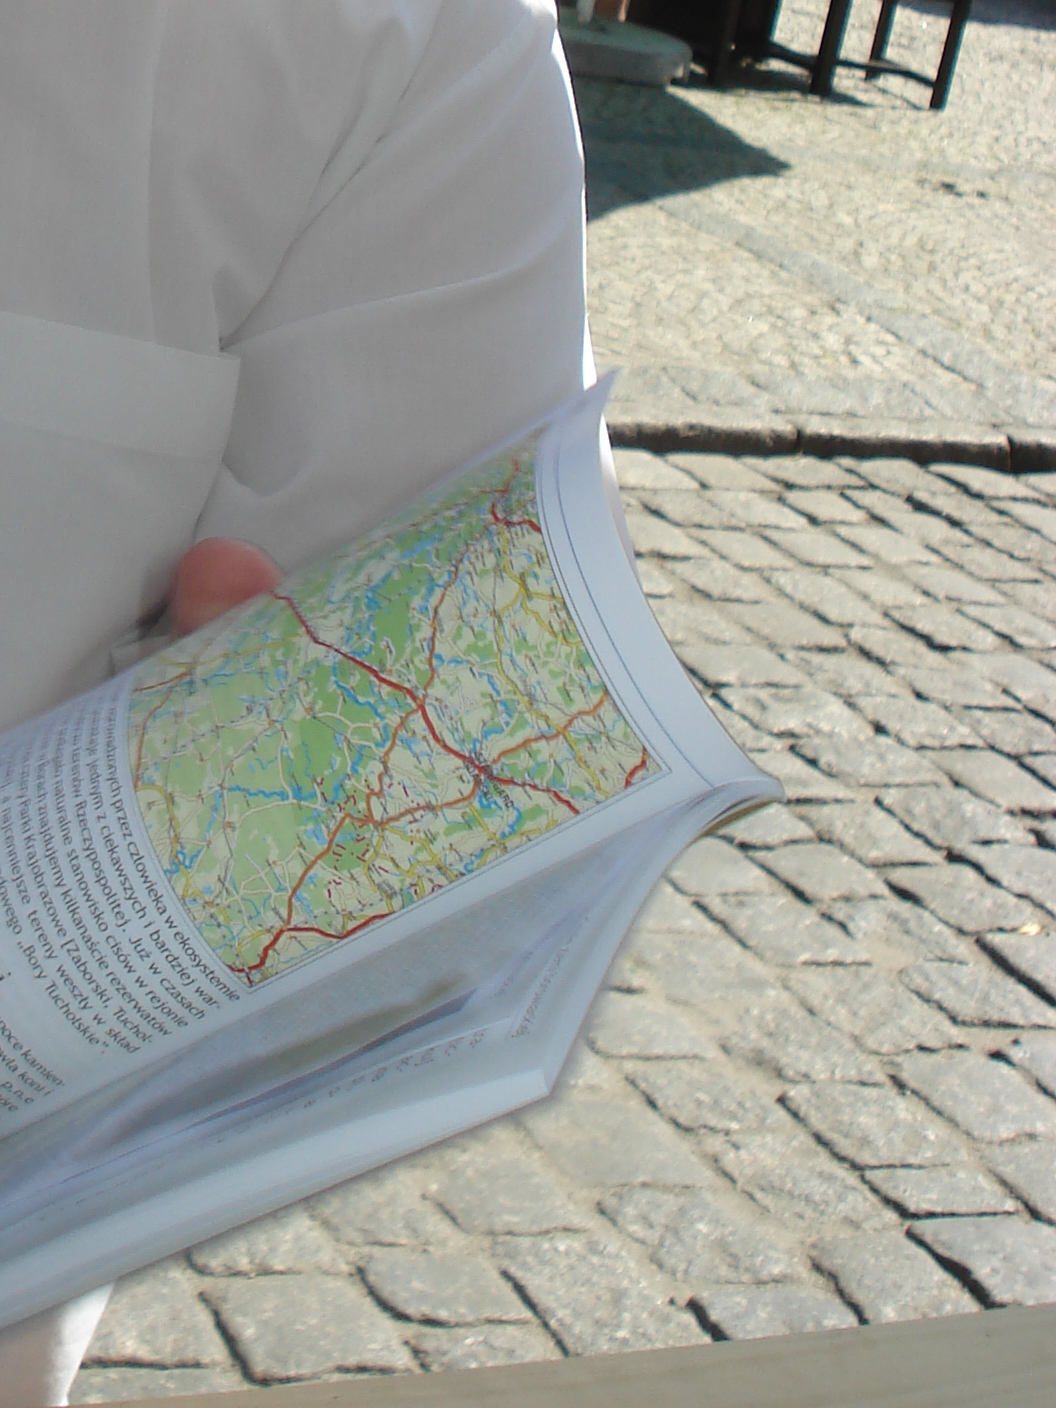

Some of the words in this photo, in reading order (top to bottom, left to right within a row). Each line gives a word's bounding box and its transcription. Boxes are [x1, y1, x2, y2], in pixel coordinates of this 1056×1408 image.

[87, 757, 104, 810] jednym
[97, 811, 107, 821] z
[53, 780, 72, 846] naturalne
[66, 846, 109, 933] stanowisko
[105, 934, 137, 974] cisów
[134, 975, 149, 989] w
[145, 990, 188, 1028] rejonie
[75, 798, 127, 933] Rzeczypospolitej.
[129, 936, 151, 962] Już
[148, 962, 162, 976] w
[160, 977, 206, 1021] czasach
[101, 825, 148, 919] ciekawszych
[110, 798, 133, 842] przez
[126, 841, 167, 917] człowieka
[165, 915, 177, 930] w
[173, 929, 241, 1003] ekosystemie
[0, 805, 32, 905] najcenniejsze
[27, 909, 58, 961] tereny
[56, 963, 93, 1012] weszły
[92, 1013, 107, 1027] w
[105, 1026, 142, 1054] skład
[22, 834, 67, 938] Krajobrazowe
[59, 938, 113, 1009] [Zaborski,
[112, 1005, 154, 1044] Tuchol-
[36, 804, 67, 889] znajdujemy
[61, 888, 110, 971] kilkanaście
[105, 970, 173, 1036] rezerwatów
[143, 920, 155, 930] i
[148, 929, 195, 987] bardziej
[194, 986, 221, 1010] war-
[17, 1070, 45, 1093] koni
[20, 1049, 65, 1088] kamien-
